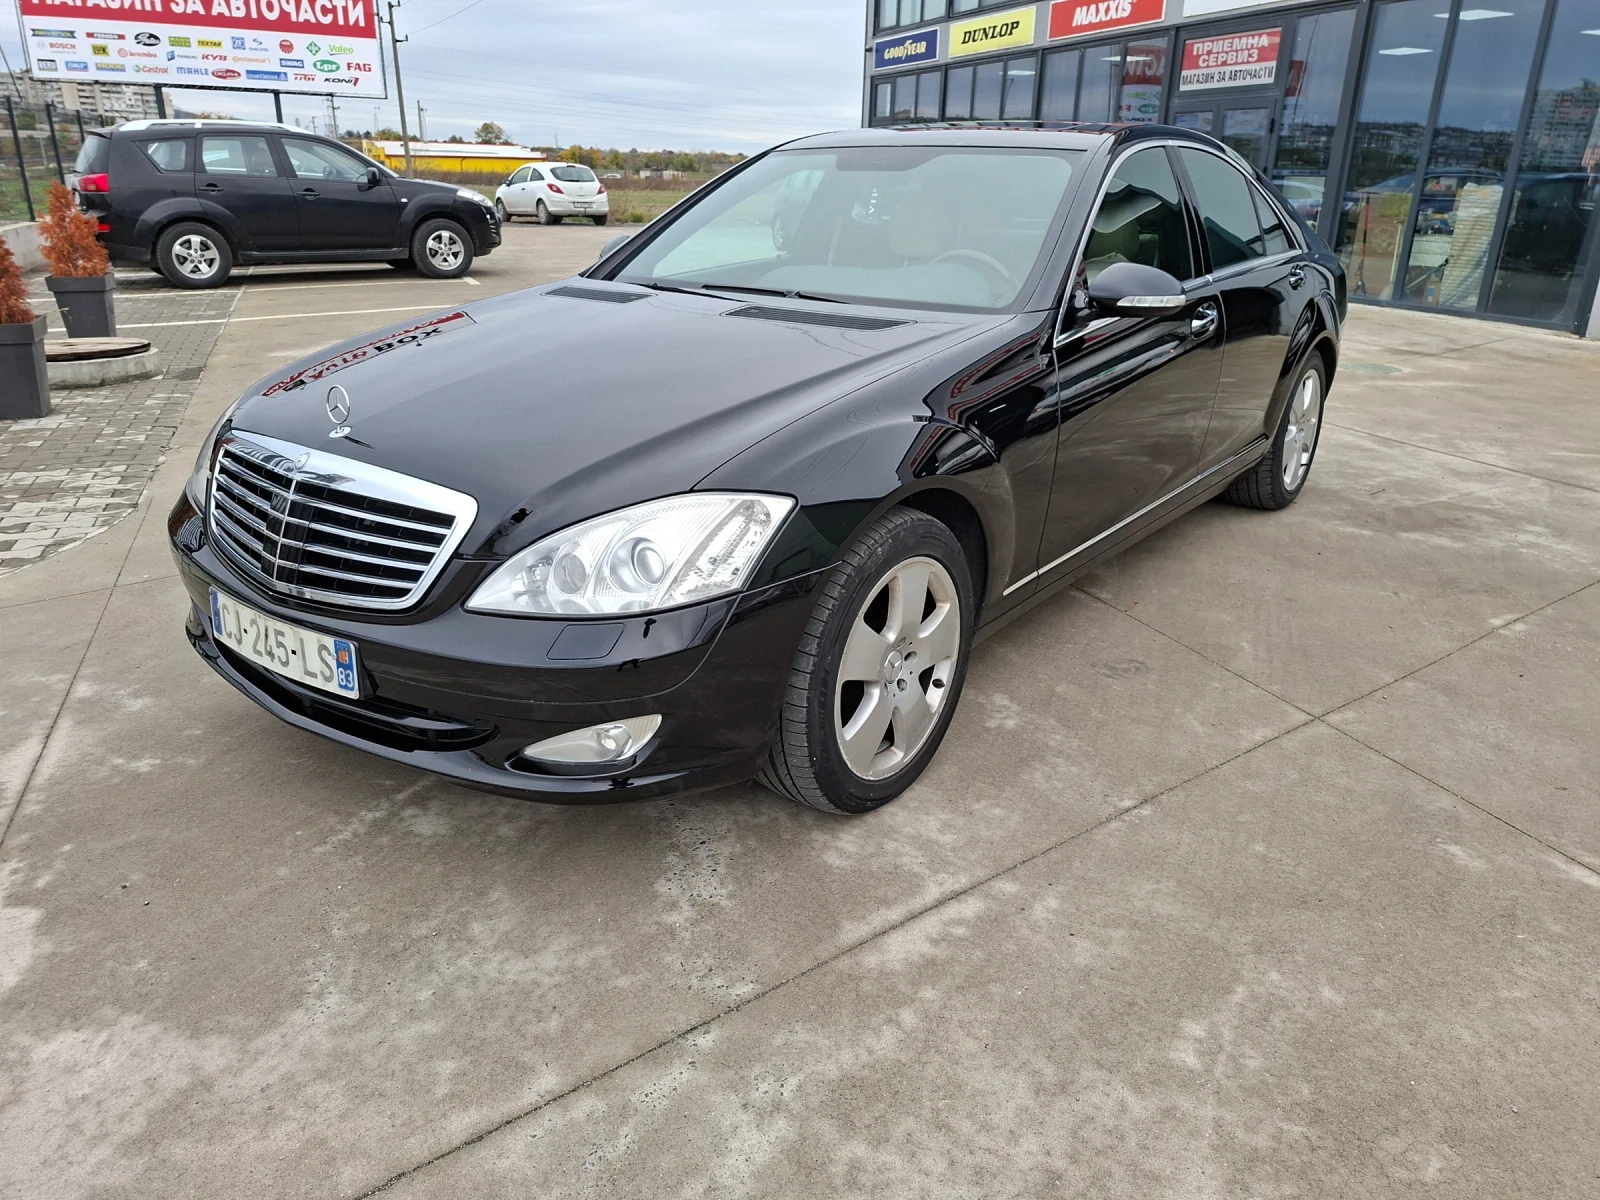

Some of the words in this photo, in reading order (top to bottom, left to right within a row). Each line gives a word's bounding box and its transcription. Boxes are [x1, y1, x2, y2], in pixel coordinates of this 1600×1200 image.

[1072, 0, 1133, 27] MAXXIS
[961, 20, 1020, 45] DUNLOP
[49, 42, 76, 50] BOSCH
[328, 44, 354, 54] Valeo
[1193, 34, 1269, 56] ПРИЕМНА
[281, 59, 303, 67] SWAG
[346, 62, 372, 72] FAG
[1198, 49, 1259, 67] СЕРВИЗ
[142, 65, 169, 74] Castrol
[176, 66, 209, 76] MAHLE
[1181, 71, 1215, 86] МАГАЗИН
[1216, 70, 1226, 83] ЗА
[1227, 66, 1274, 82] АВТОЧАСТИ
[222, 603, 335, 683] CJ-245-LS
[337, 667, 354, 688] 83
